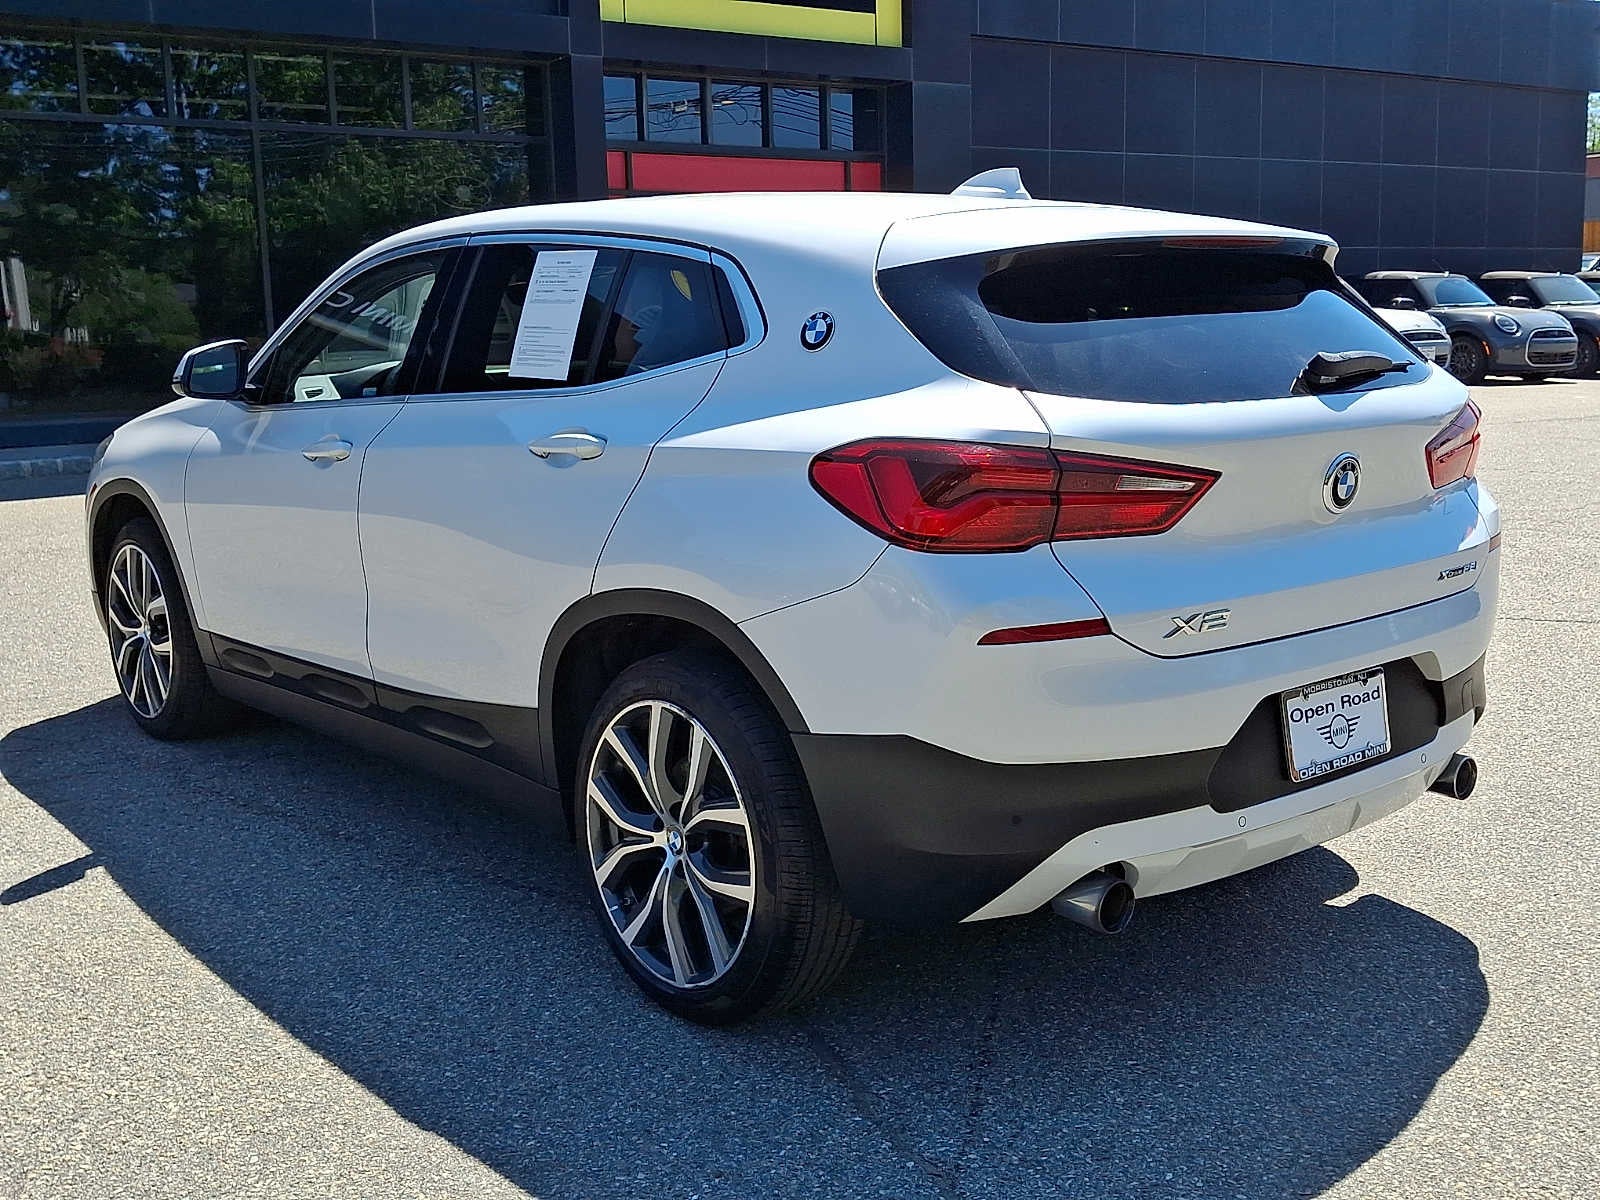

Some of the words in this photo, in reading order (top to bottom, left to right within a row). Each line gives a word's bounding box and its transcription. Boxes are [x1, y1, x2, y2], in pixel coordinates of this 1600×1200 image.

[1357, 672, 1368, 682] NJ
[1289, 702, 1335, 723] Open
[1340, 686, 1381, 709] Road
[1332, 725, 1348, 738] MINI
[1300, 761, 1331, 779] OPEN
[1332, 751, 1363, 769] ROAD
[1365, 743, 1387, 758] MINI
